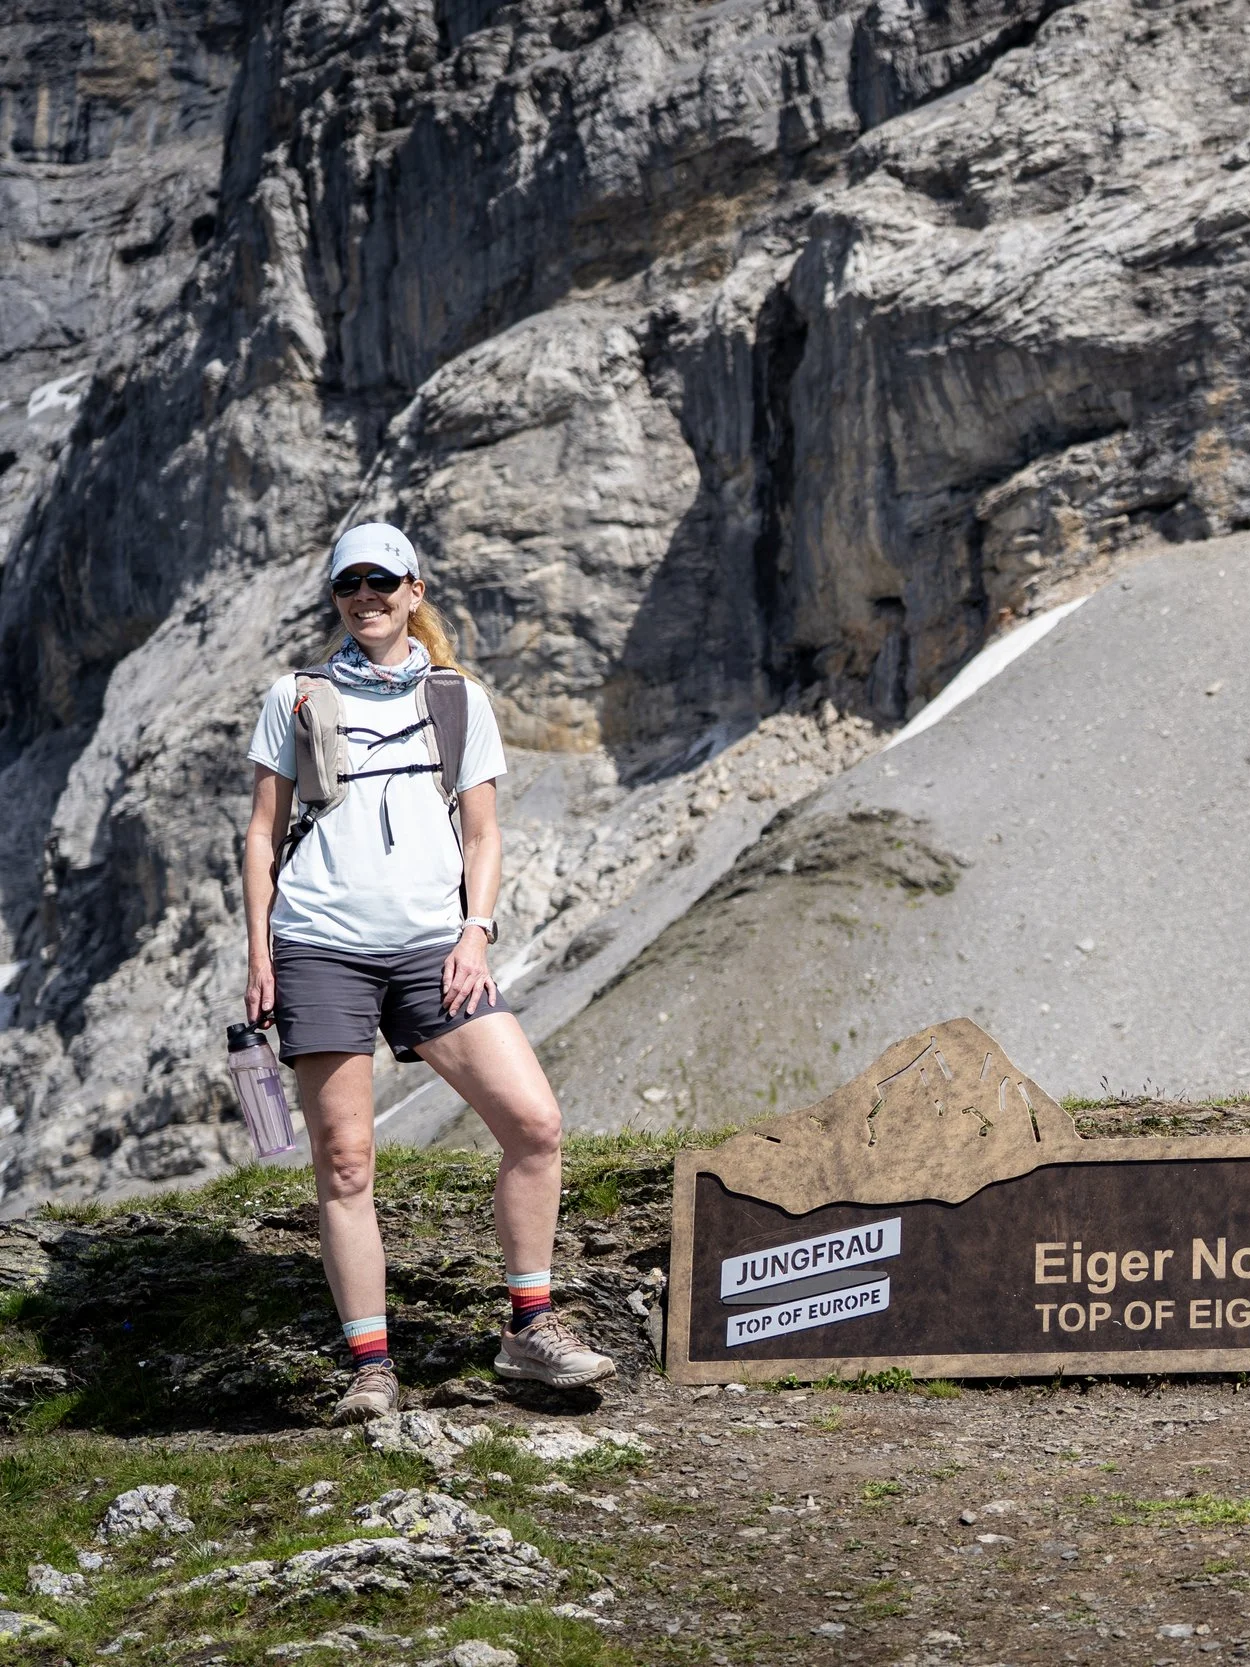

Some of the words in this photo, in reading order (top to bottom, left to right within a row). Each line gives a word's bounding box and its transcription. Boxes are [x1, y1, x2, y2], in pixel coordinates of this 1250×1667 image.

[736, 1229, 884, 1286] JUNGFRAU
[1034, 1241, 1175, 1295] Eiger
[735, 1315, 772, 1337] TOP
[778, 1307, 803, 1327] OF
[808, 1289, 881, 1320] EUROPE
[1034, 1302, 1112, 1333] TOP
[1123, 1300, 1176, 1331] OF
